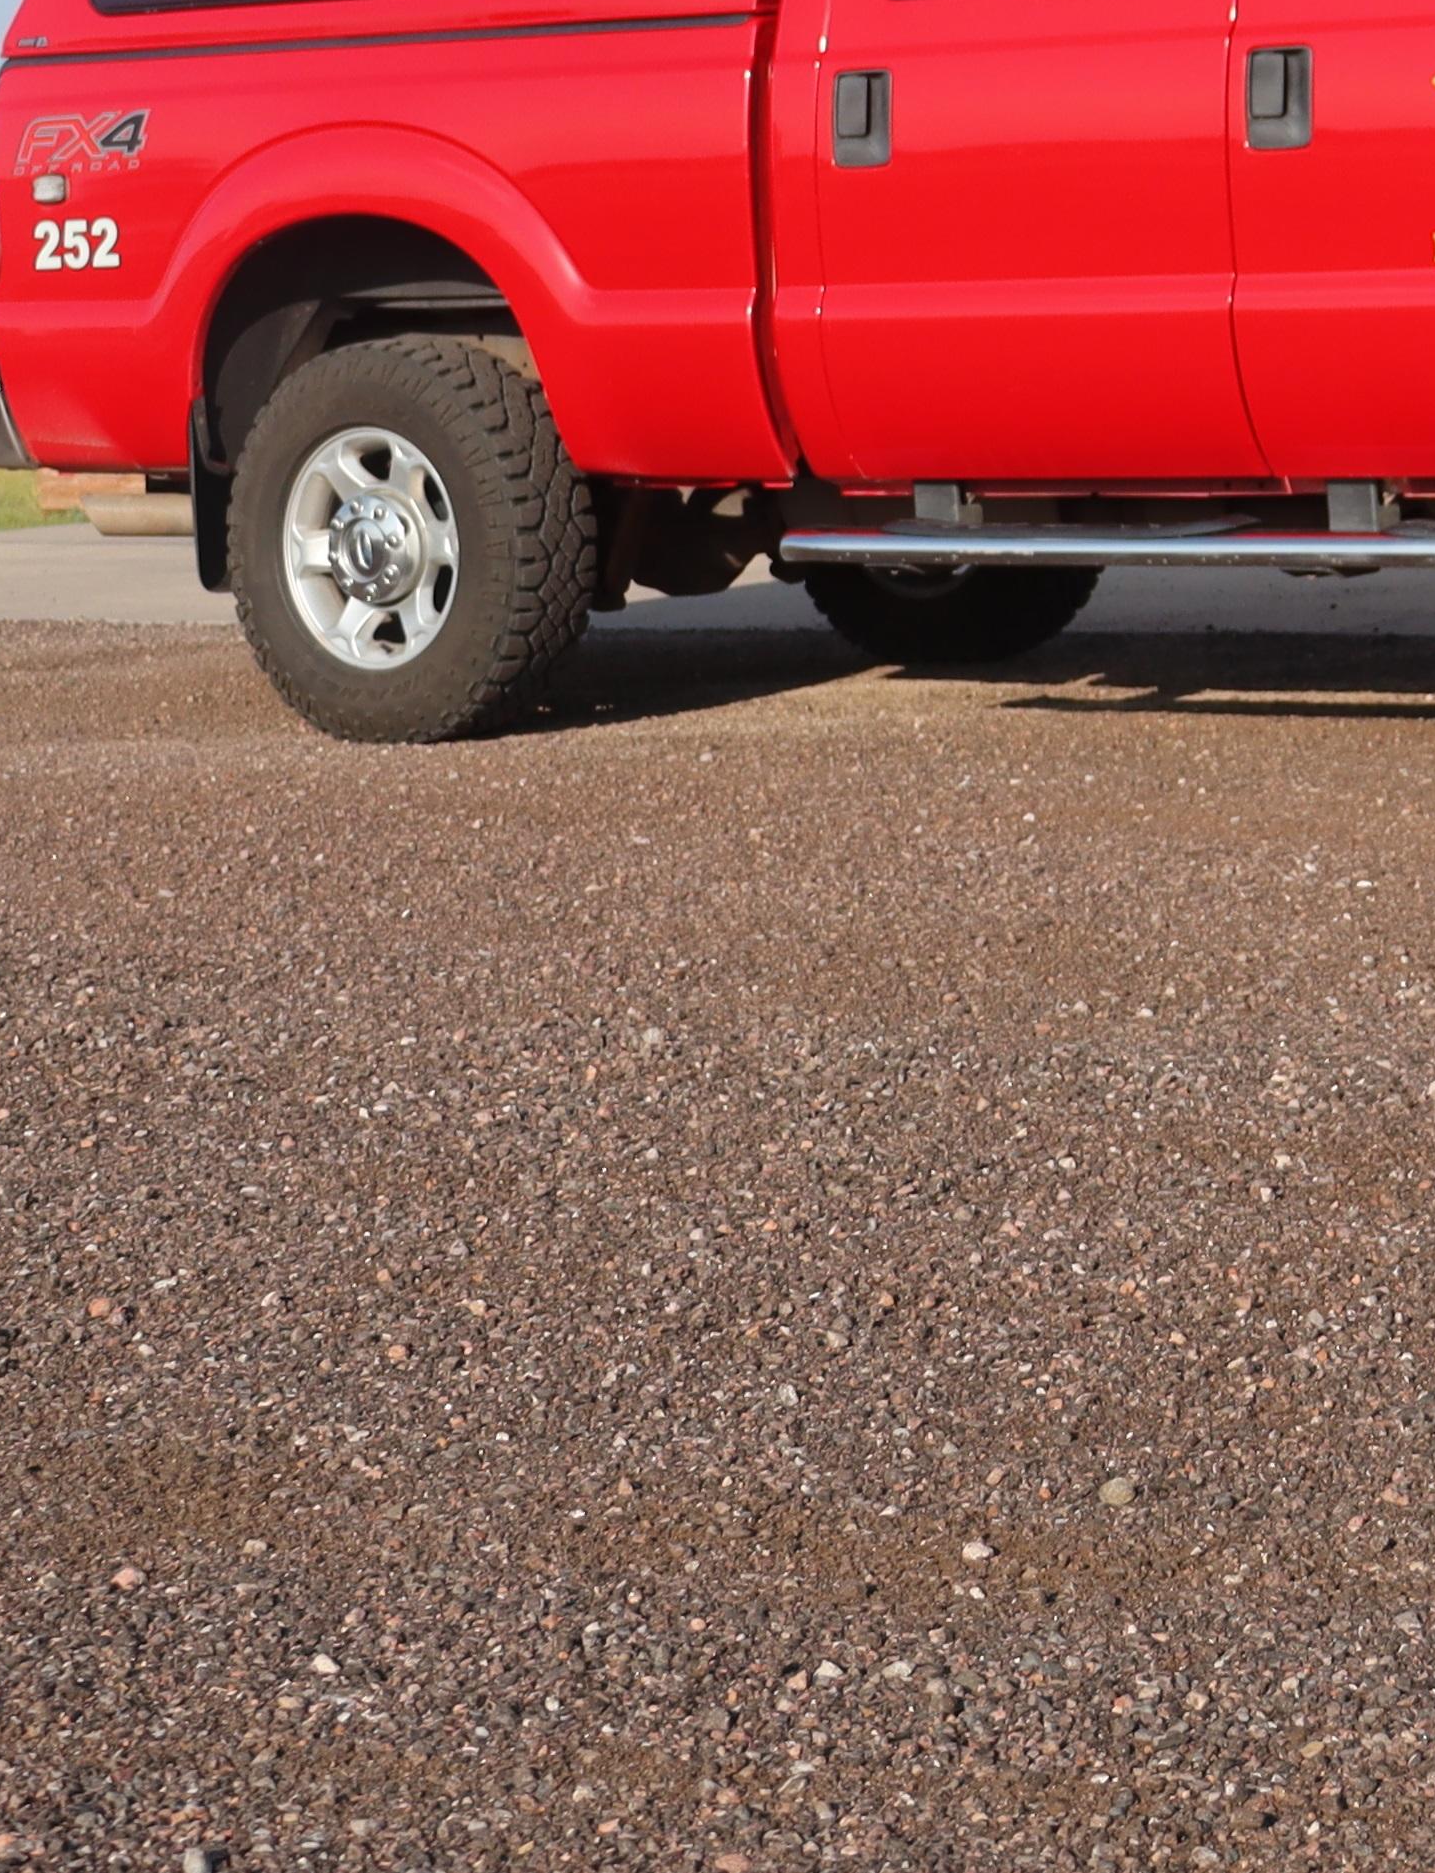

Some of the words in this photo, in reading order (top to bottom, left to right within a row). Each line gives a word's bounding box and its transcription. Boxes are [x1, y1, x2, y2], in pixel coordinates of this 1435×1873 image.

[16, 108, 151, 165] FX4
[70, 158, 140, 174] ROAD
[33, 215, 121, 271] 252
